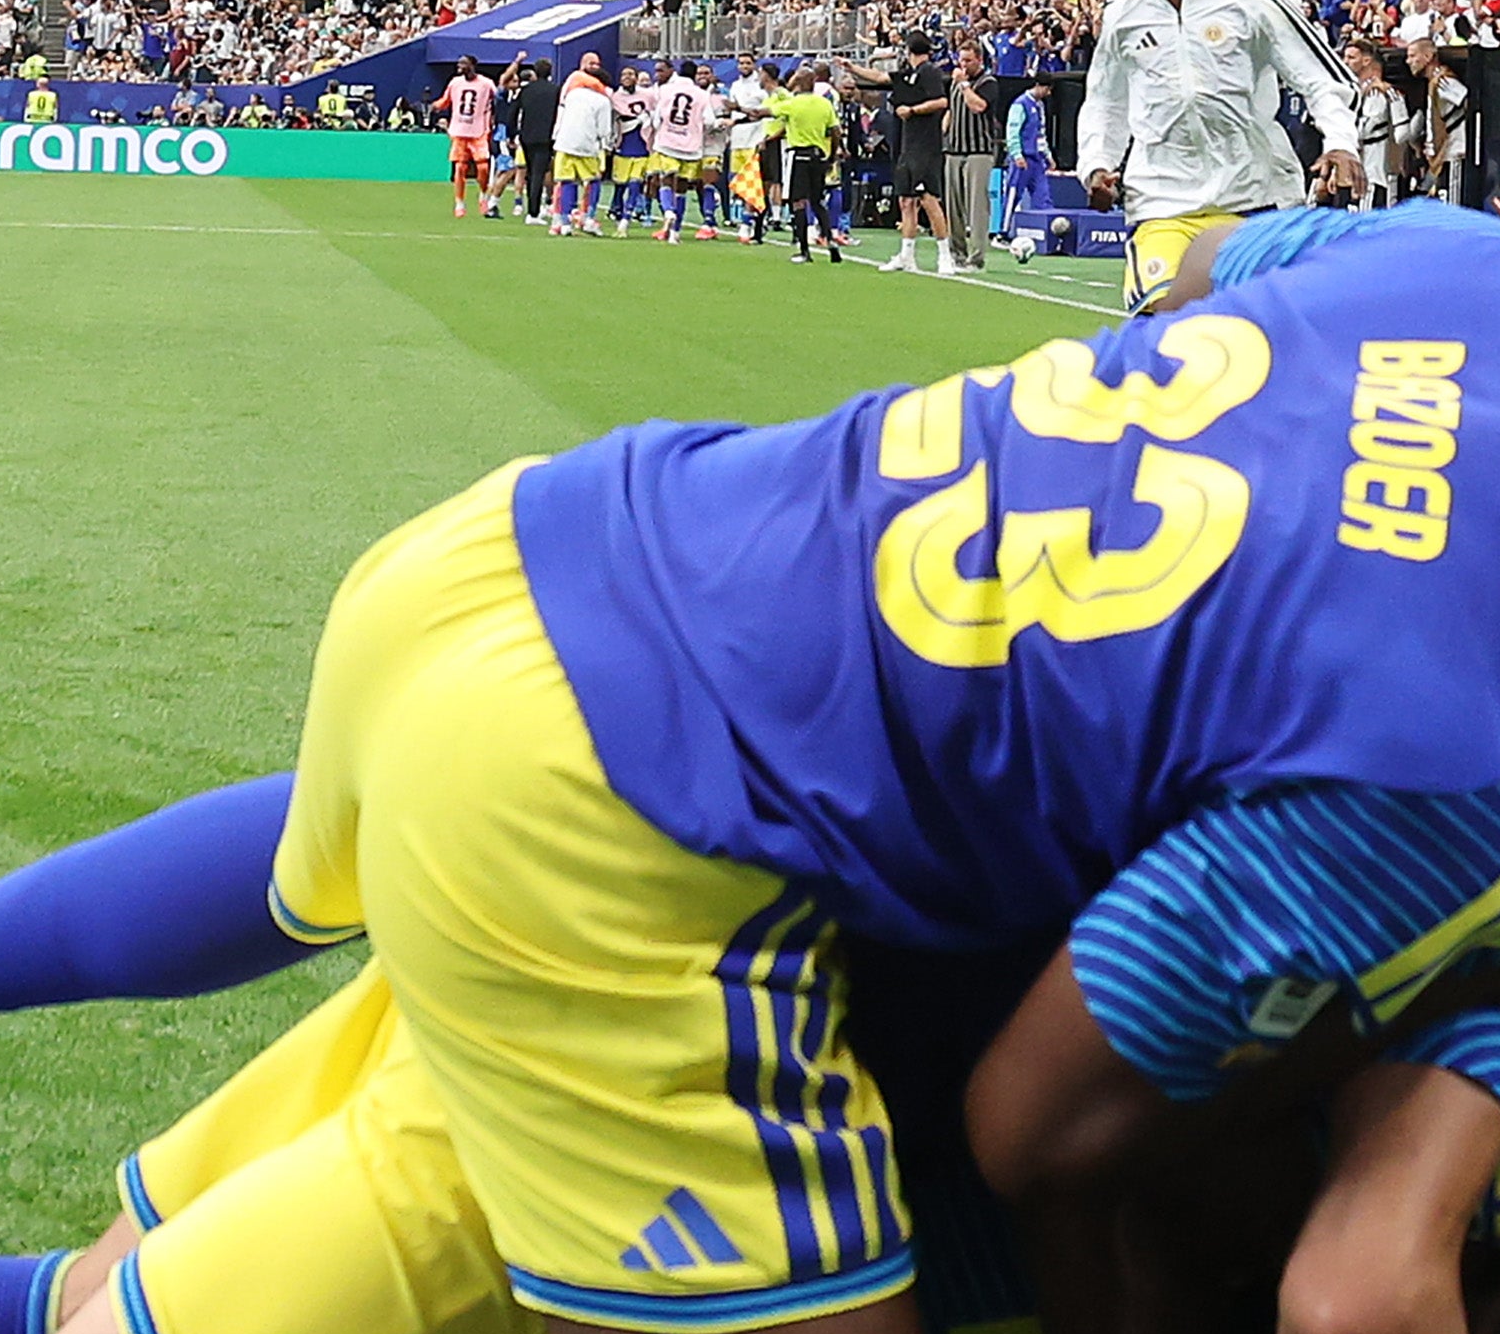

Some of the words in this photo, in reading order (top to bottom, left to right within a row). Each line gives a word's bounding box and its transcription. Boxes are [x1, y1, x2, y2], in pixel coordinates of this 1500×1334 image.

[1091, 230, 1117, 242] FIFA
[874, 315, 1272, 668] 23
[1337, 340, 1467, 562] BAZOER
